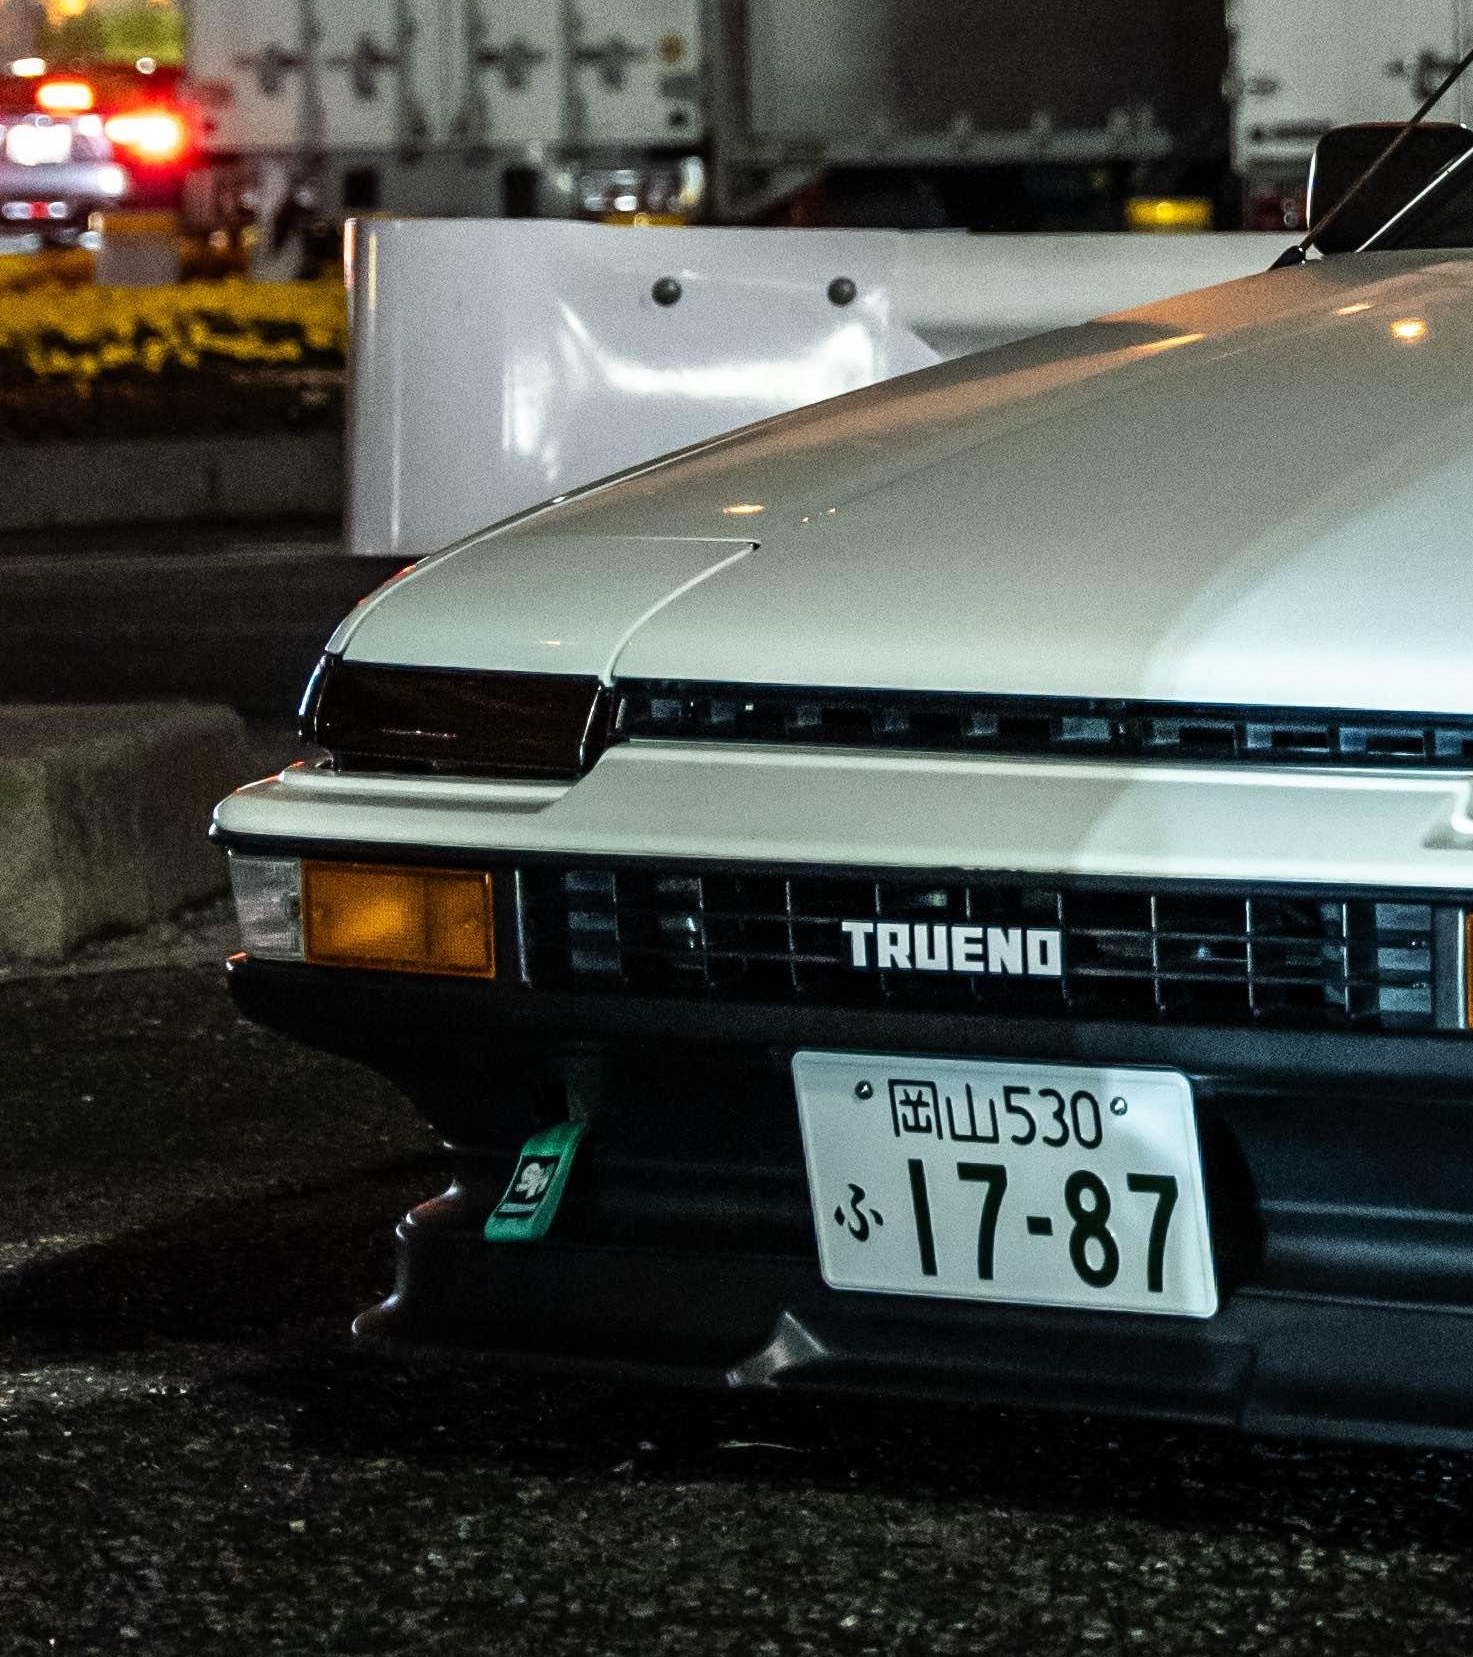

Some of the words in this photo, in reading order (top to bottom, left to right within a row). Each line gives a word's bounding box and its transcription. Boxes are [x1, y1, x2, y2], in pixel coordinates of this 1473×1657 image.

[841, 921, 1062, 975] TRUENO
[834, 1183, 884, 1242] ふ
[908, 1158, 1180, 1293] 17-87
